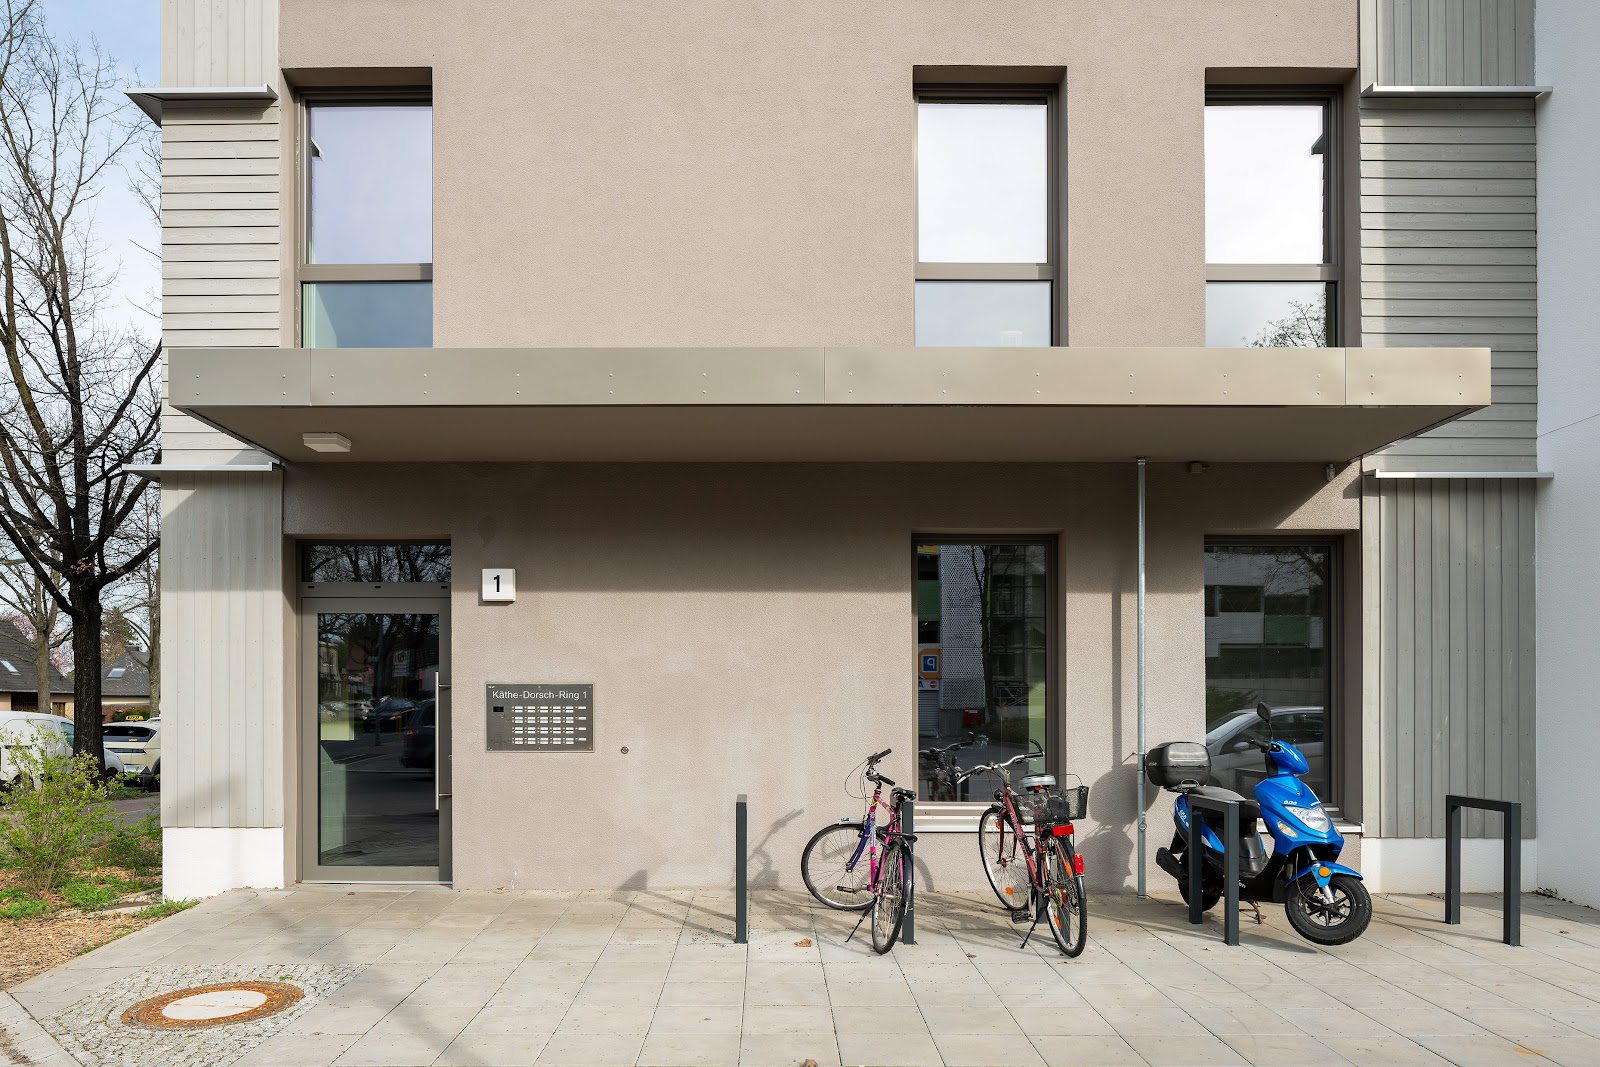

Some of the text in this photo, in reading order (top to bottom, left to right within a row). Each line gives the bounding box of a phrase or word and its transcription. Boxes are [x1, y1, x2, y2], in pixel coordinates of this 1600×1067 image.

[493, 574, 500, 592] 1
[492, 690, 587, 700] Käthe-Dorsch-Ring 1
